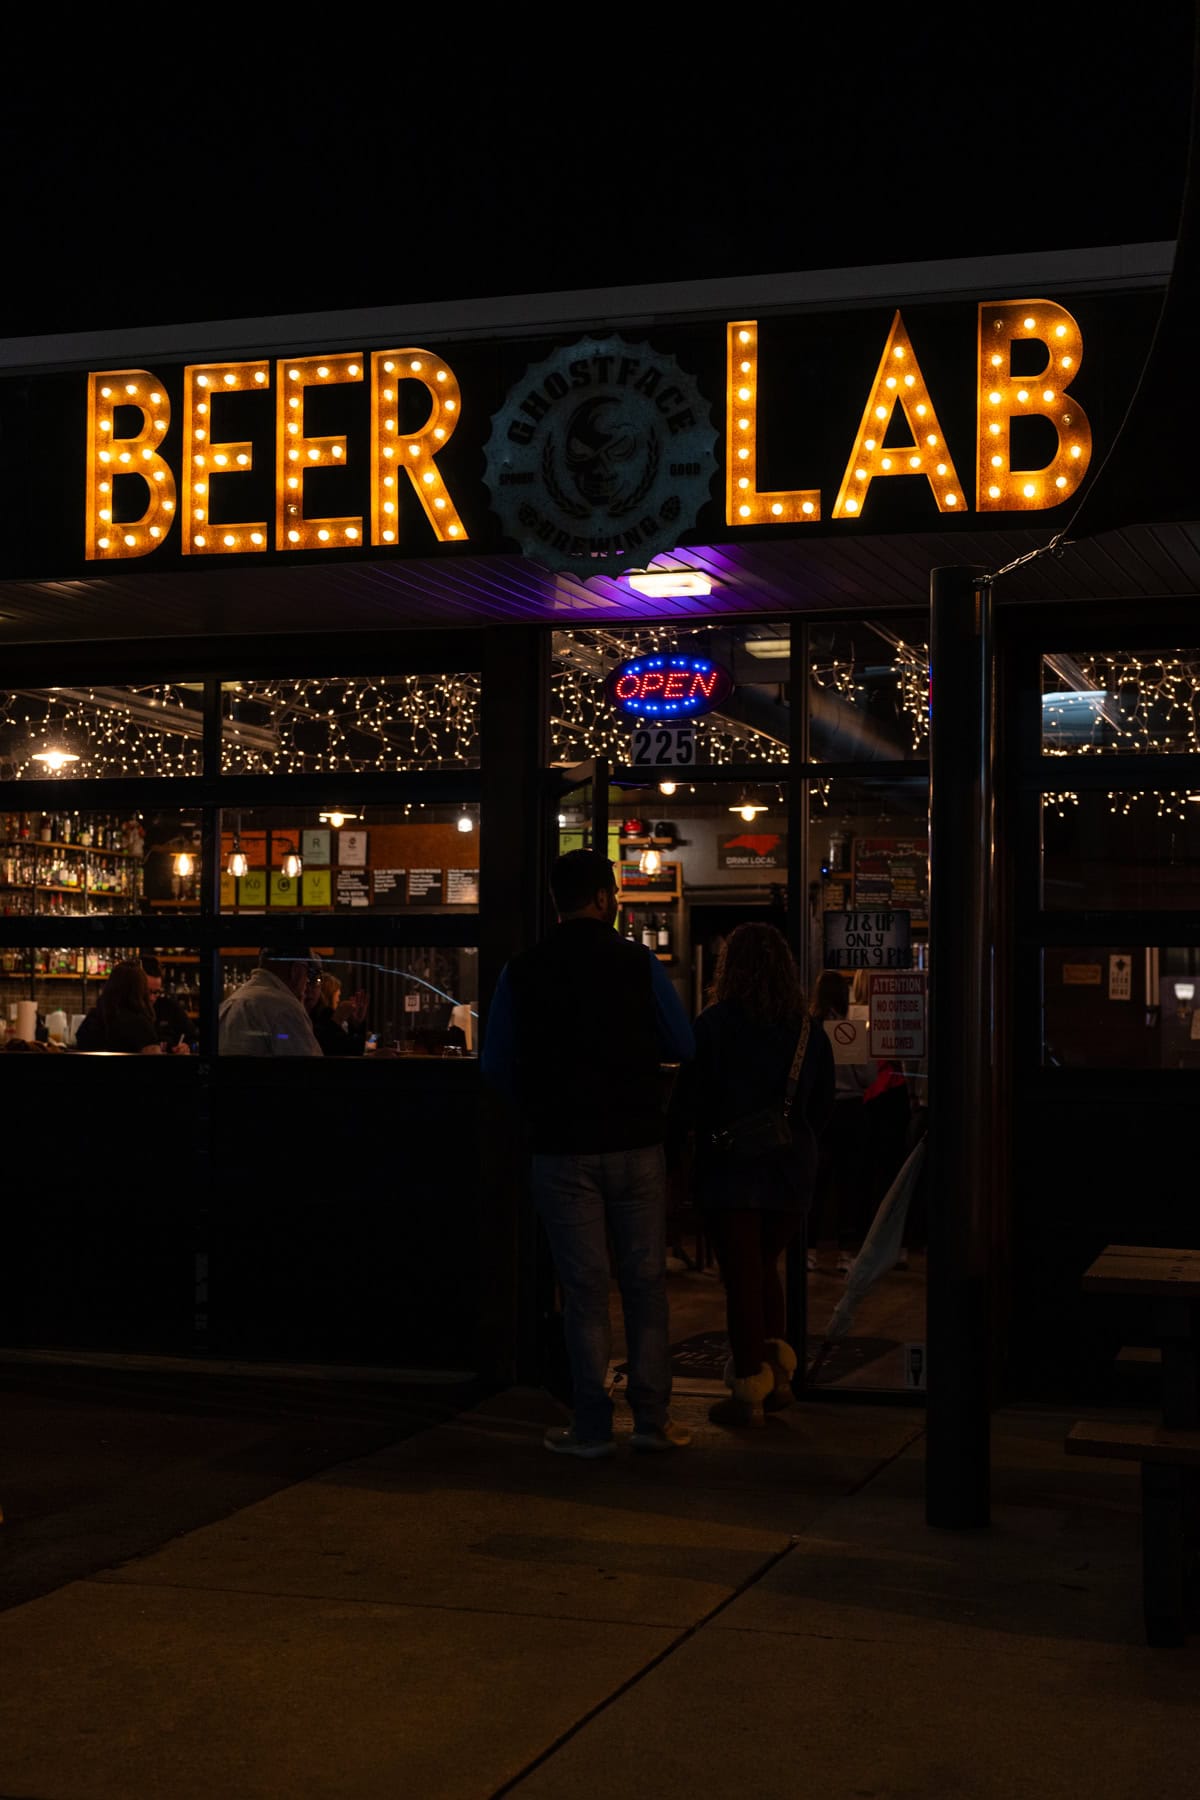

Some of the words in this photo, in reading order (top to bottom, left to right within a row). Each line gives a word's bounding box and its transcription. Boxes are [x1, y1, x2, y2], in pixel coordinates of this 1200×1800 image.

[508, 356, 697, 445] GHOSTFACE
[85, 346, 470, 562] BEER
[725, 297, 1094, 528] LAB
[536, 516, 658, 557] BREWING
[615, 671, 718, 699] OPEN
[635, 730, 693, 765] 225
[750, 856, 777, 865] LOCAL
[861, 914, 872, 931] &
[875, 914, 895, 931] UP
[846, 933, 884, 947] ONLY
[826, 948, 869, 966] AFTER
[873, 948, 883, 965] 9
[873, 978, 921, 993] ATTENTION
[876, 1000, 888, 1012] NO
[888, 1000, 919, 1012] OUTSIDE
[873, 1019, 890, 1031] FOOD
[880, 1036, 914, 1049] ALLOWED
